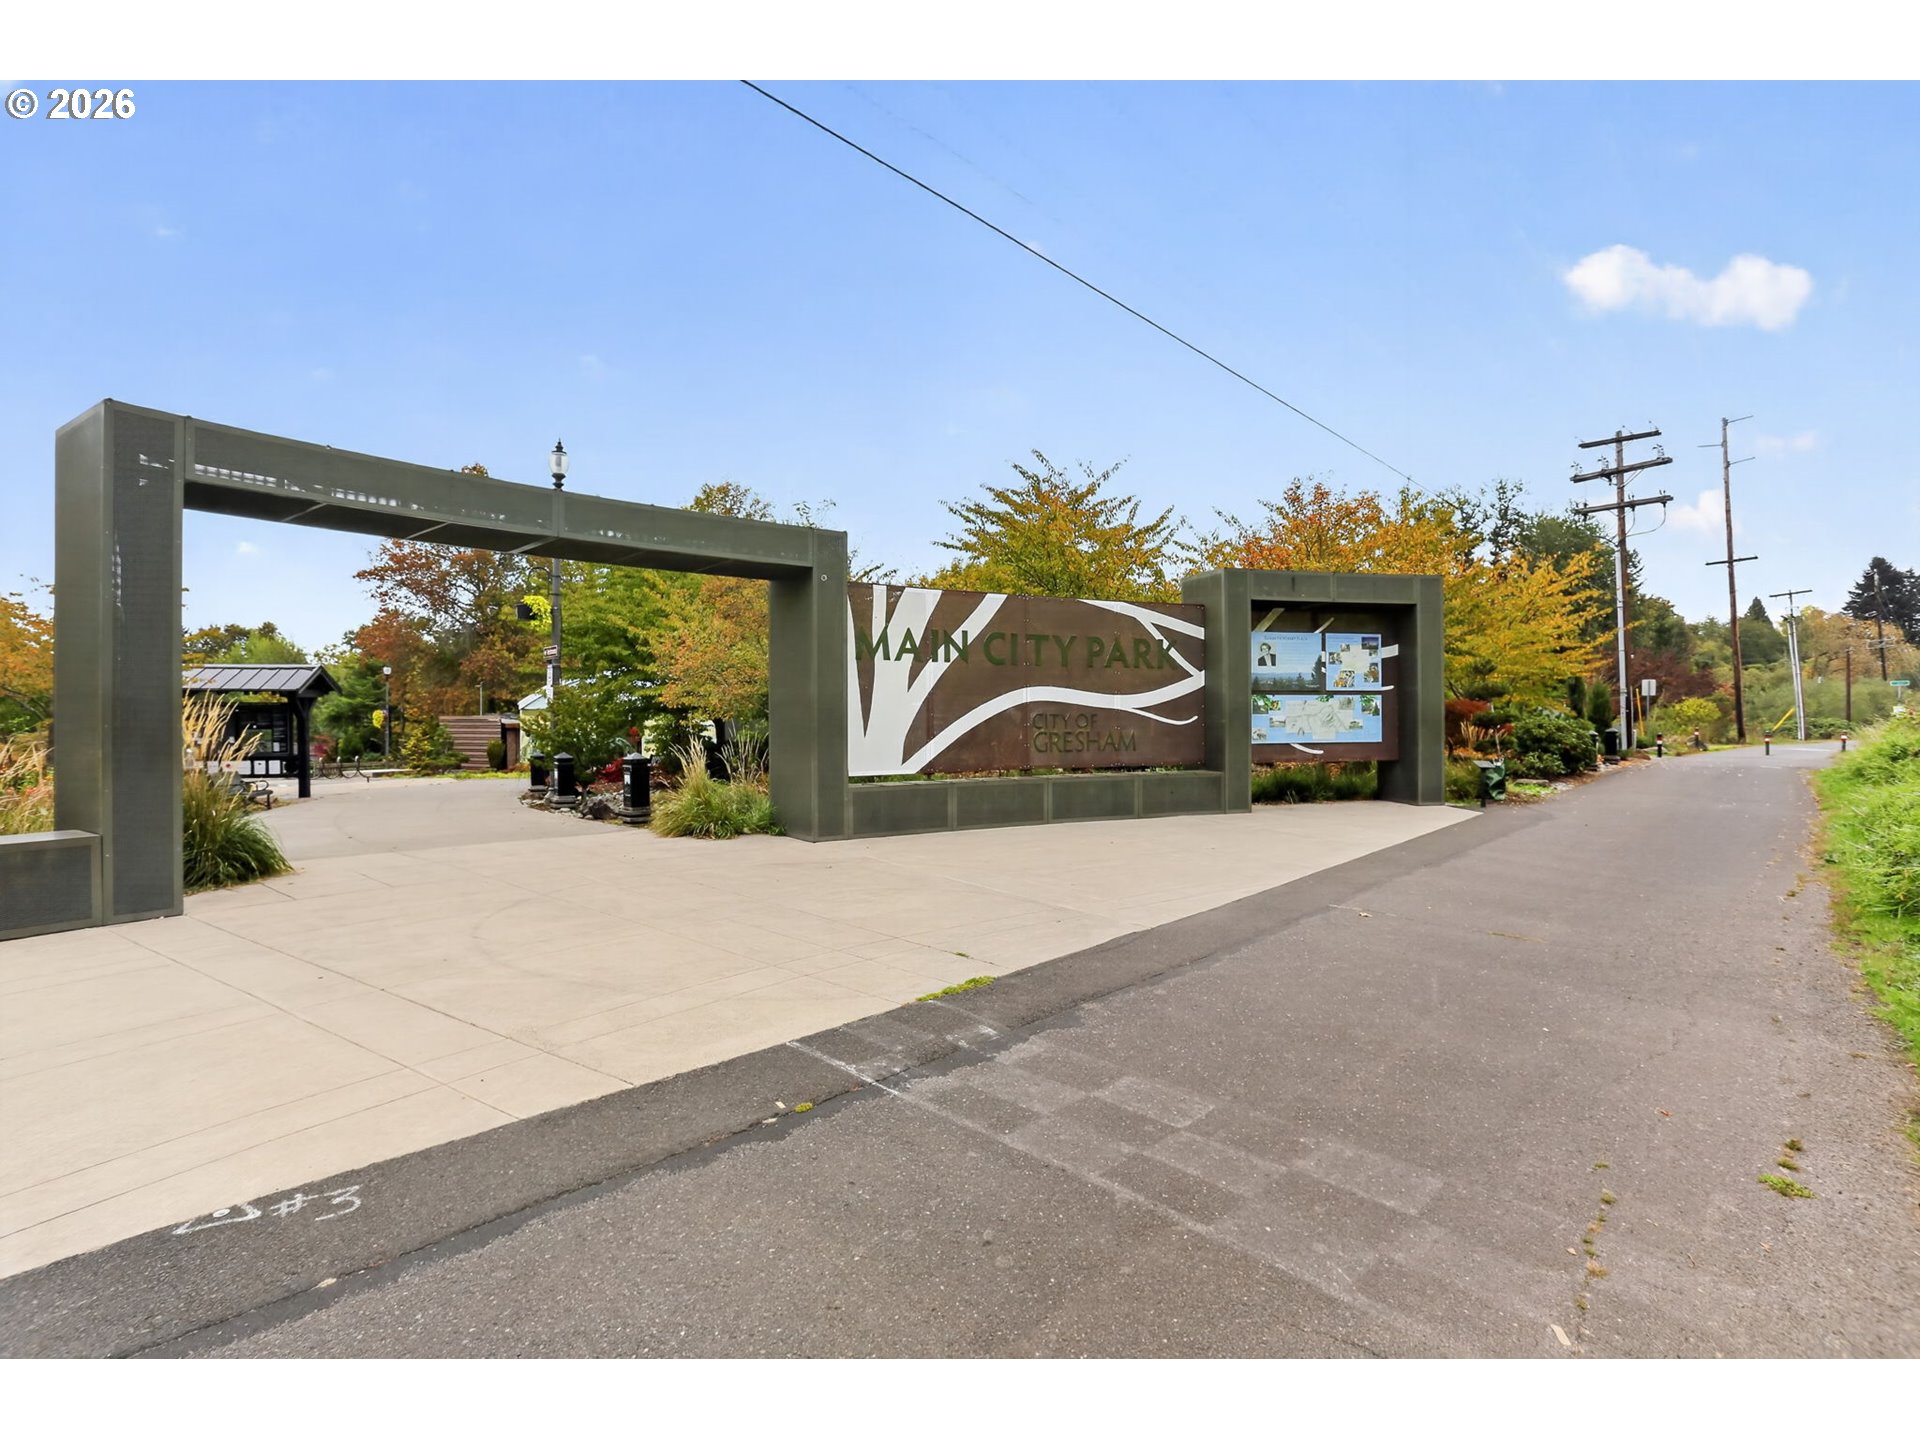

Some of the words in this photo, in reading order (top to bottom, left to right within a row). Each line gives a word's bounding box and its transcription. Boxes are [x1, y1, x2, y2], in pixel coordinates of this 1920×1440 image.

[854, 624, 969, 664] MAIN
[983, 631, 1077, 668] CITY
[1087, 635, 1178, 670] PARK
[1032, 713, 1070, 730] CITY
[1075, 713, 1098, 729] OF
[1033, 729, 1137, 753] GRESHAM
